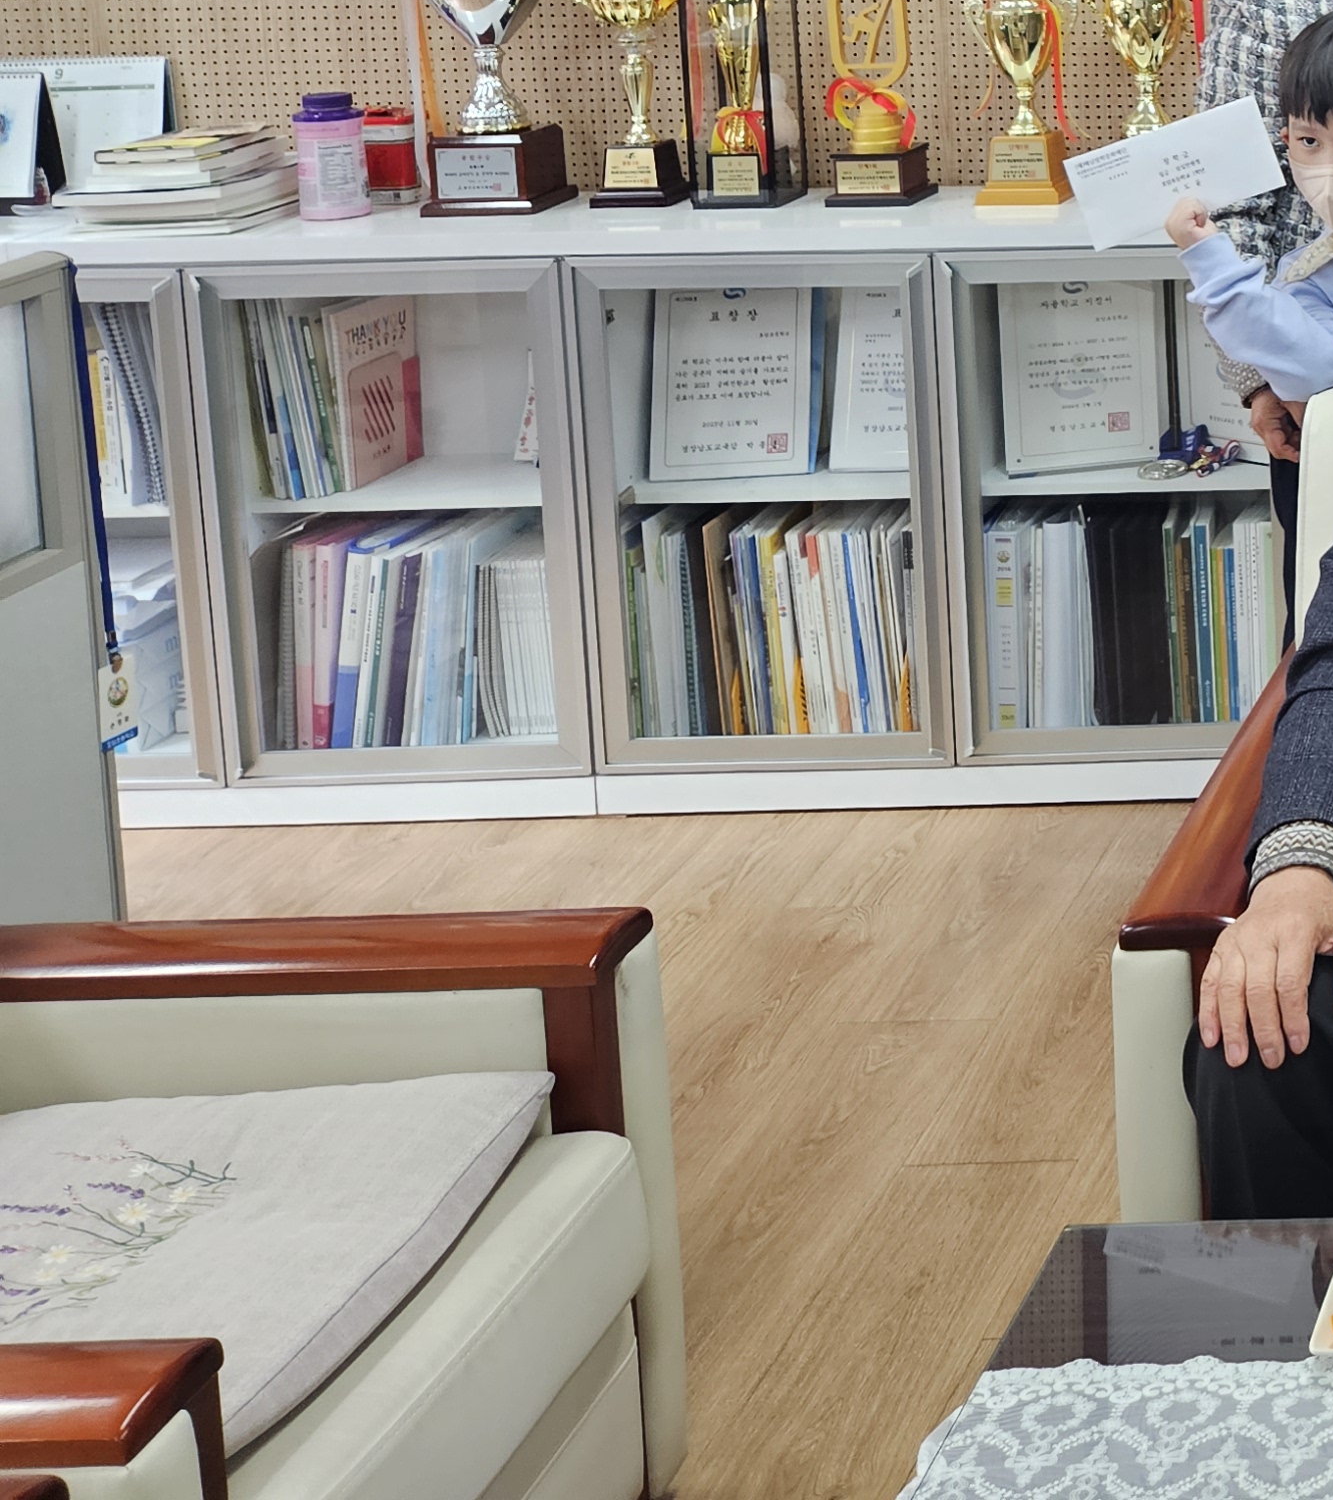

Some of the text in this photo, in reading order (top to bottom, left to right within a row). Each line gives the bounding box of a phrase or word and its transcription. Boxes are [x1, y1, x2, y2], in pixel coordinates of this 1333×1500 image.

[55, 69, 63, 79] 9
[345, 310, 406, 344] THANK YOU
